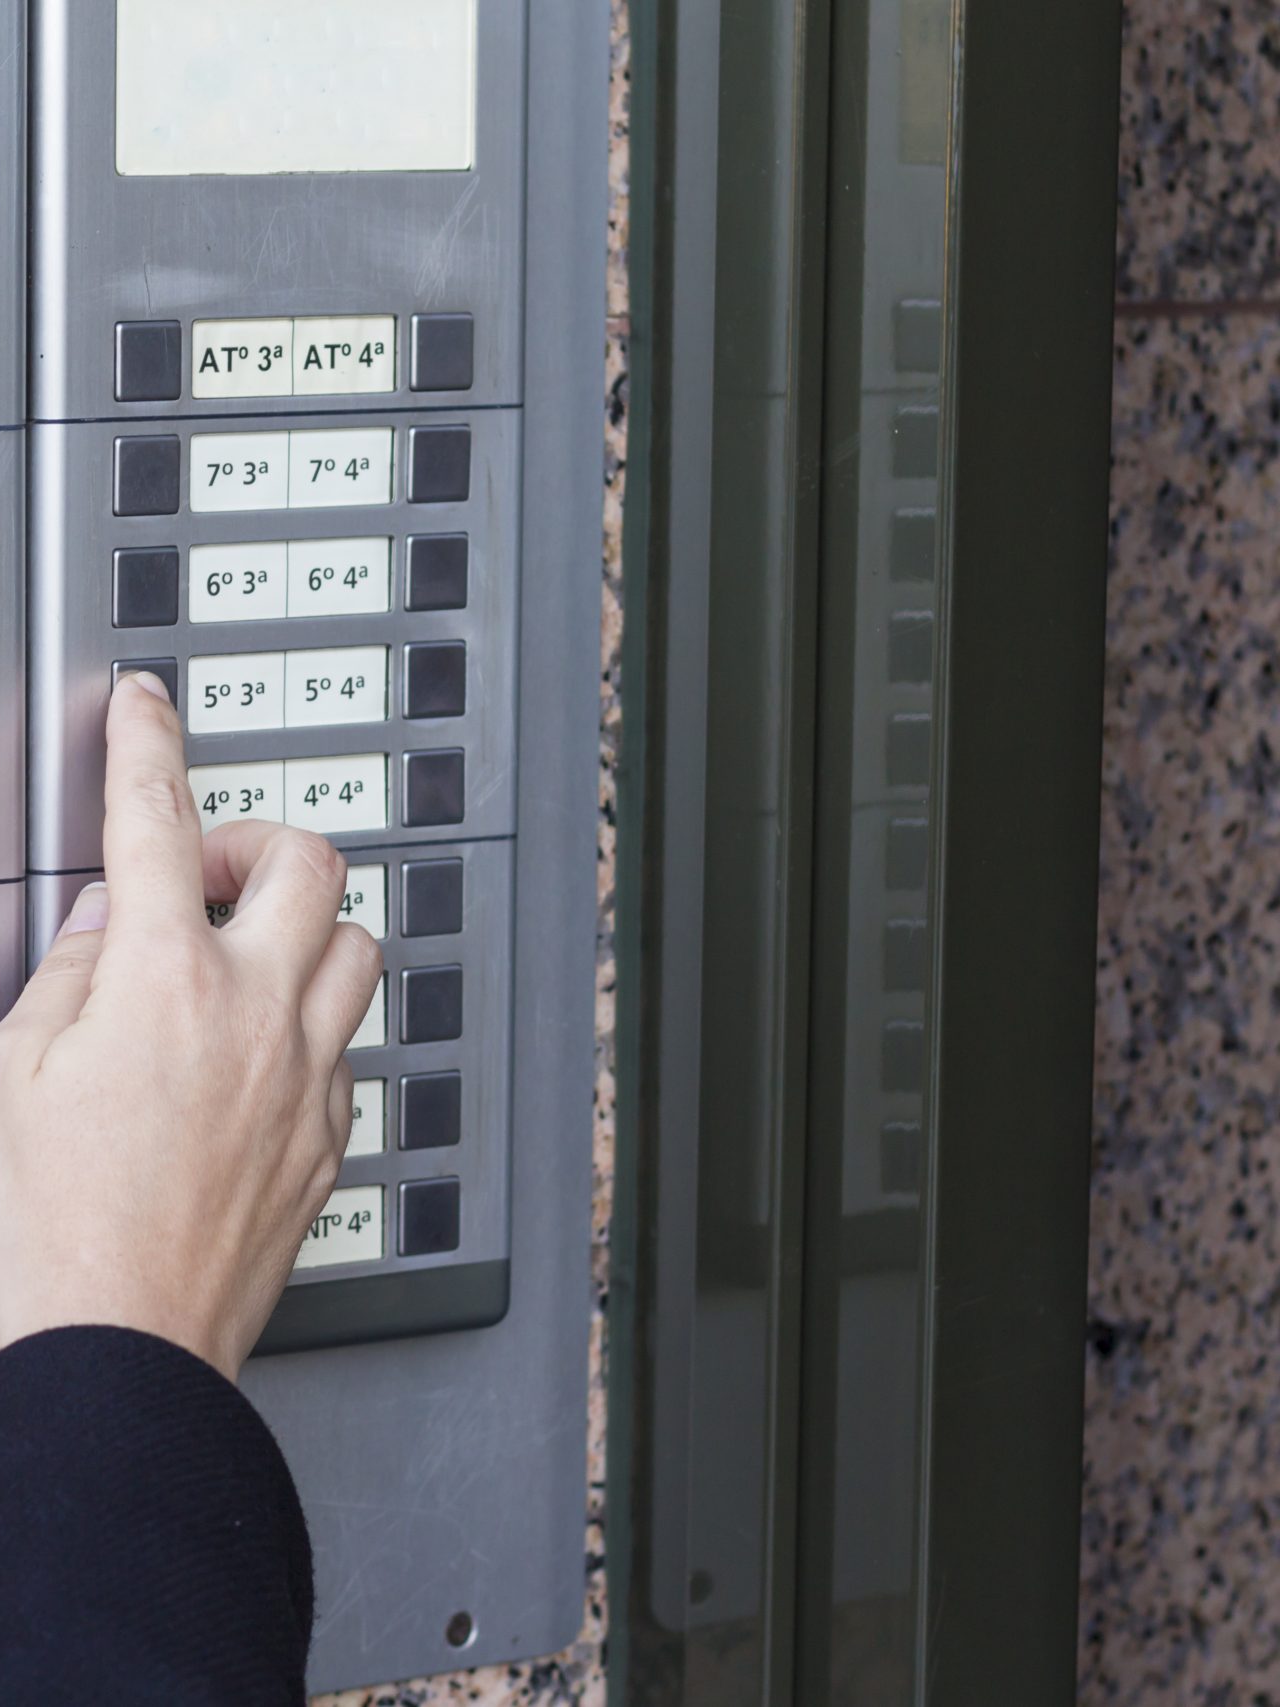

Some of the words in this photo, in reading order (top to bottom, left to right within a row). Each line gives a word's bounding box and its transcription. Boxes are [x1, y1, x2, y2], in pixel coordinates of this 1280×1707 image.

[257, 344, 284, 372] 3ª
[358, 341, 385, 368] 4ª
[206, 462, 234, 487] 7º
[242, 461, 269, 486] 3ª
[309, 458, 336, 483] 7º
[344, 457, 370, 481] 4ª
[206, 571, 234, 597] 6º
[242, 570, 268, 595] 3ª
[308, 567, 335, 592] 6º
[342, 565, 369, 590] 4ª
[204, 683, 231, 709] 5º
[240, 681, 265, 707] 3ª
[305, 677, 332, 702] 5º
[340, 675, 365, 700] 4ª
[202, 790, 230, 816] 4º
[239, 787, 264, 813] 3ª
[303, 782, 330, 807] 4º
[338, 780, 364, 805] 4ª
[304, 1213, 343, 1241] NTº
[347, 1210, 372, 1234] 4ª
